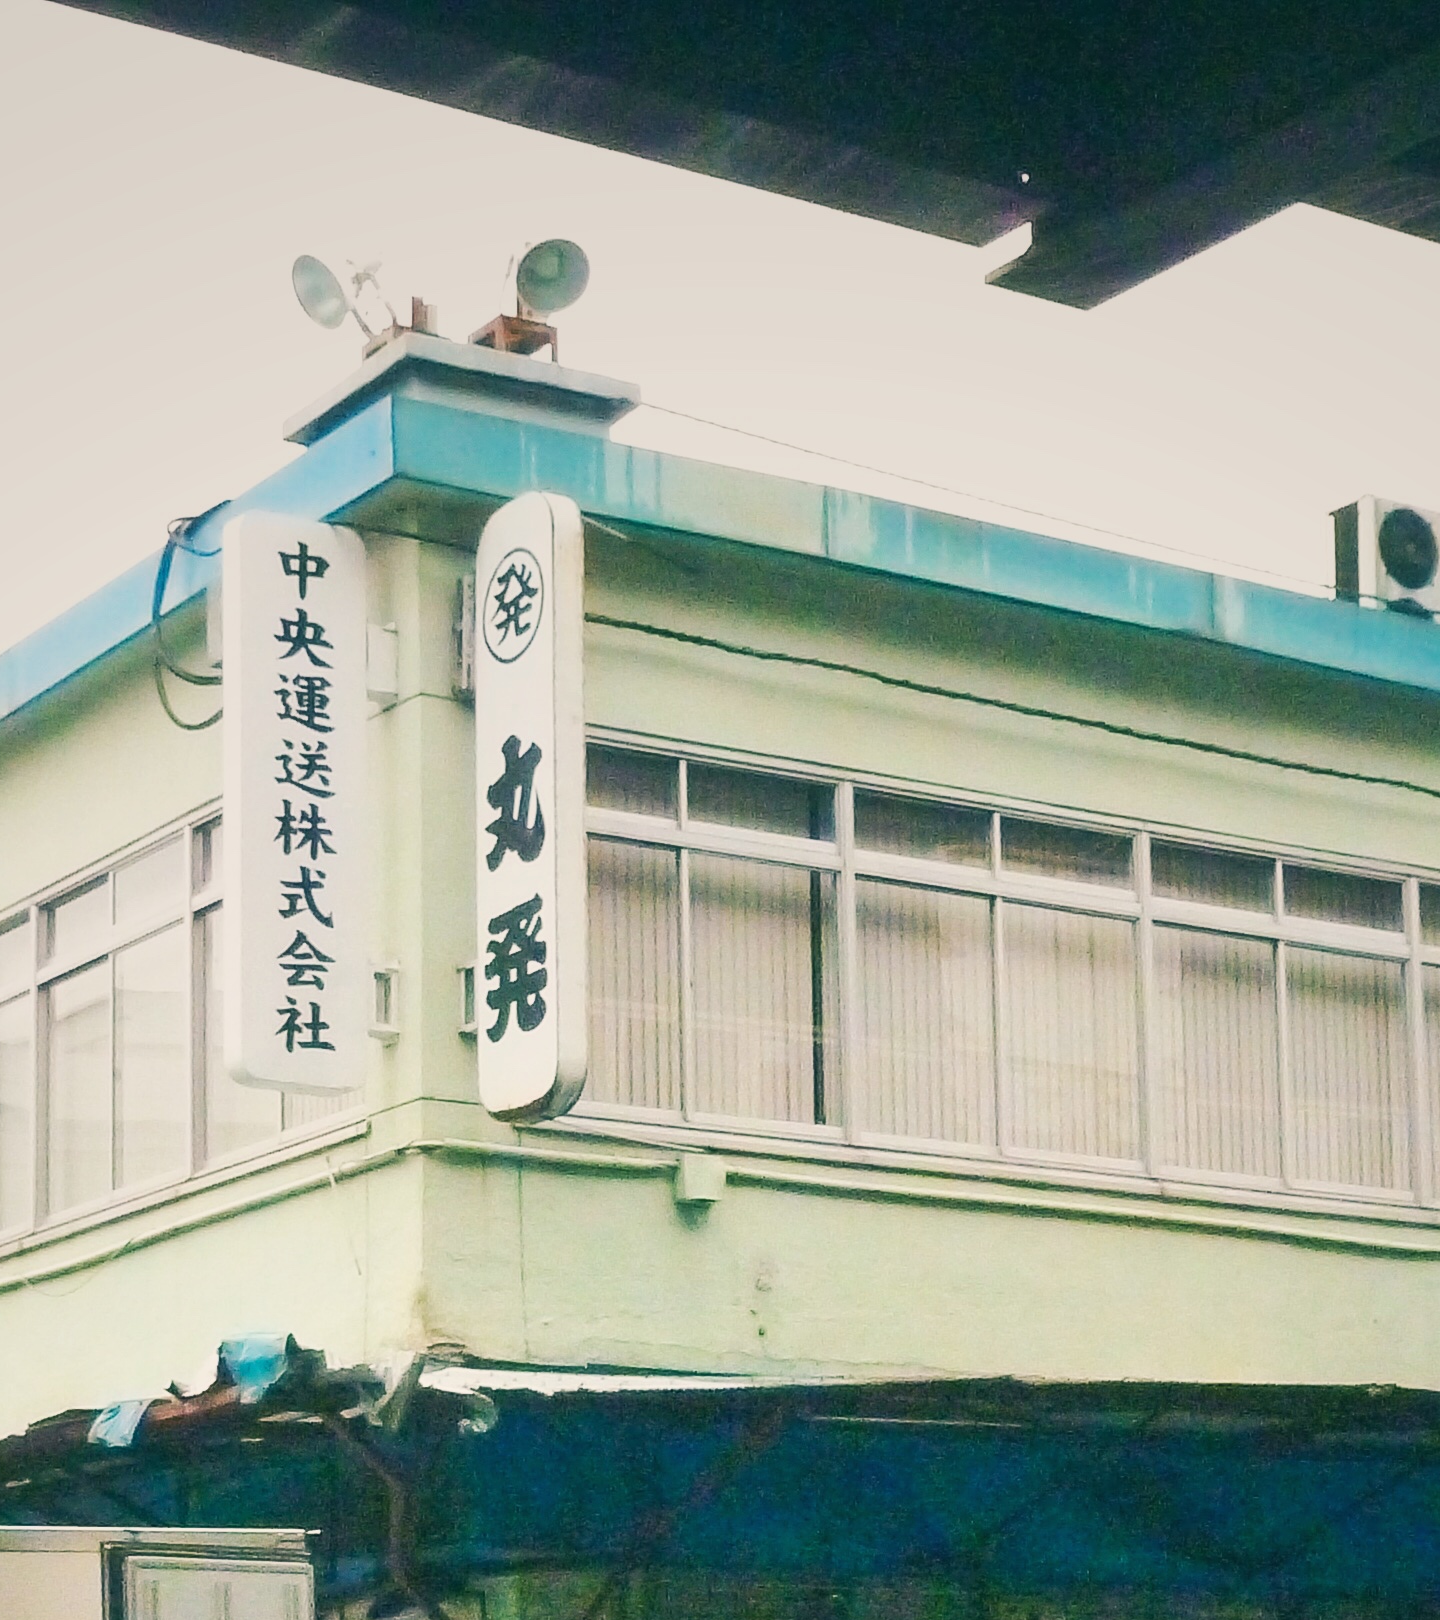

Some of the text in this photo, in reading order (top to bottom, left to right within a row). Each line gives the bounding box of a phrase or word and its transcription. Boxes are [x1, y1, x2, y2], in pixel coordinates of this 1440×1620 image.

[272, 541, 338, 1054] 中央運送株式会社
[485, 733, 548, 1043] 丸発
